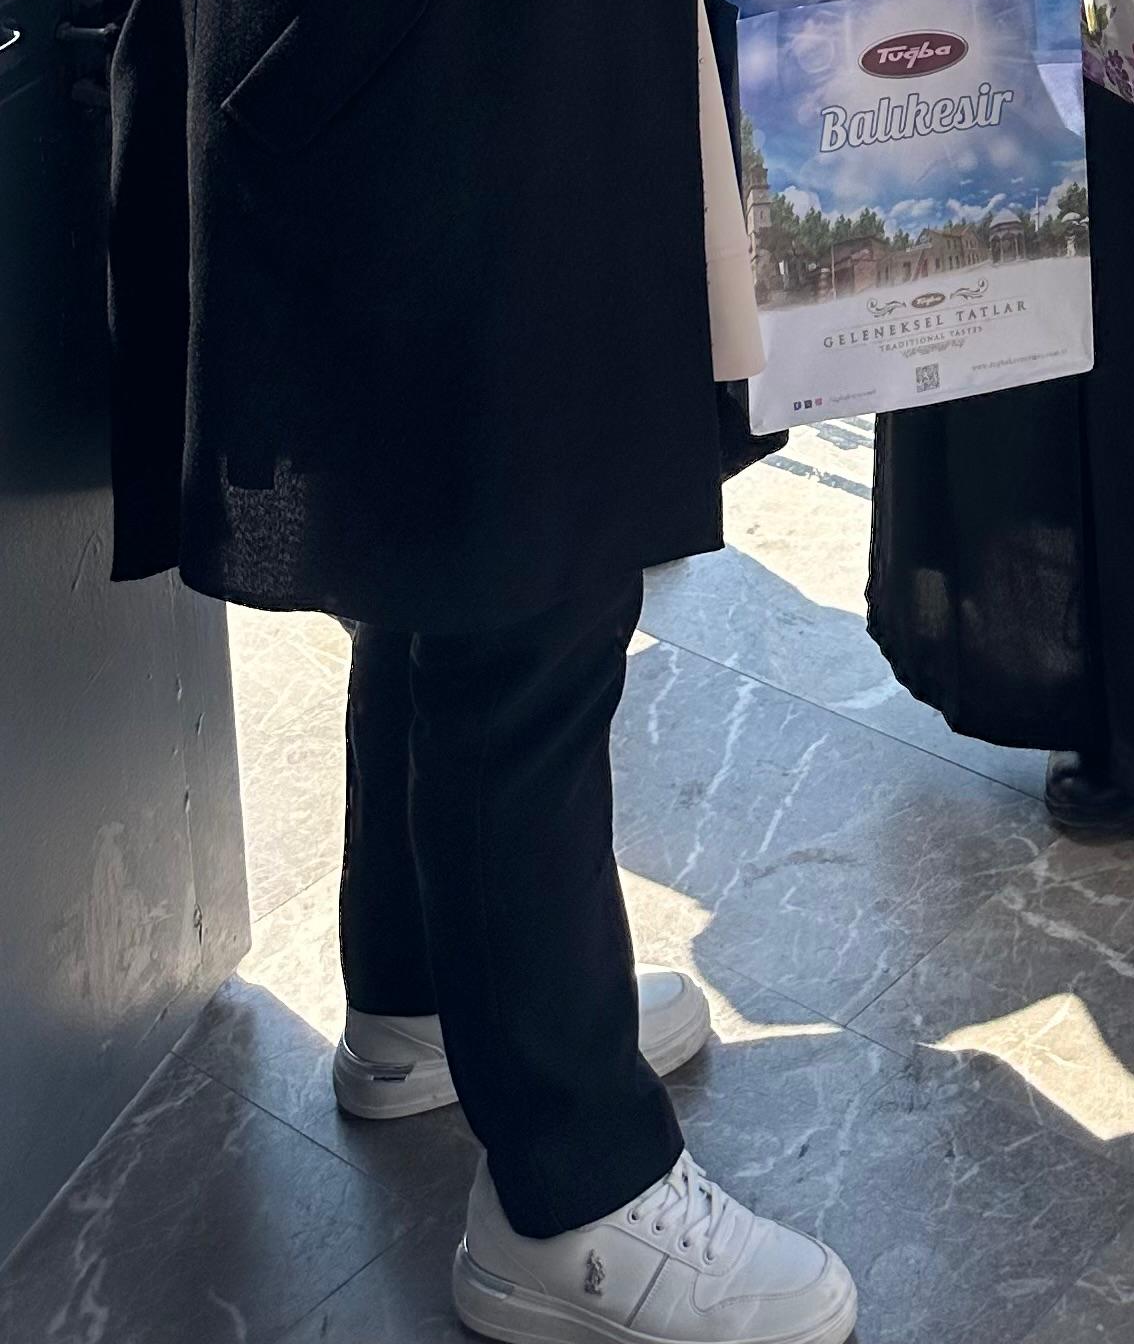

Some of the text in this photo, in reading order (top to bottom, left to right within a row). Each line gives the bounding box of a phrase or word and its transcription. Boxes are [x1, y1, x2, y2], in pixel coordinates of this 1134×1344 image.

[820, 82, 1014, 153] Balıkesir
[823, 301, 1026, 348] GELENEKSEL TATLAR
[880, 332, 945, 353] TRADITIONAL
